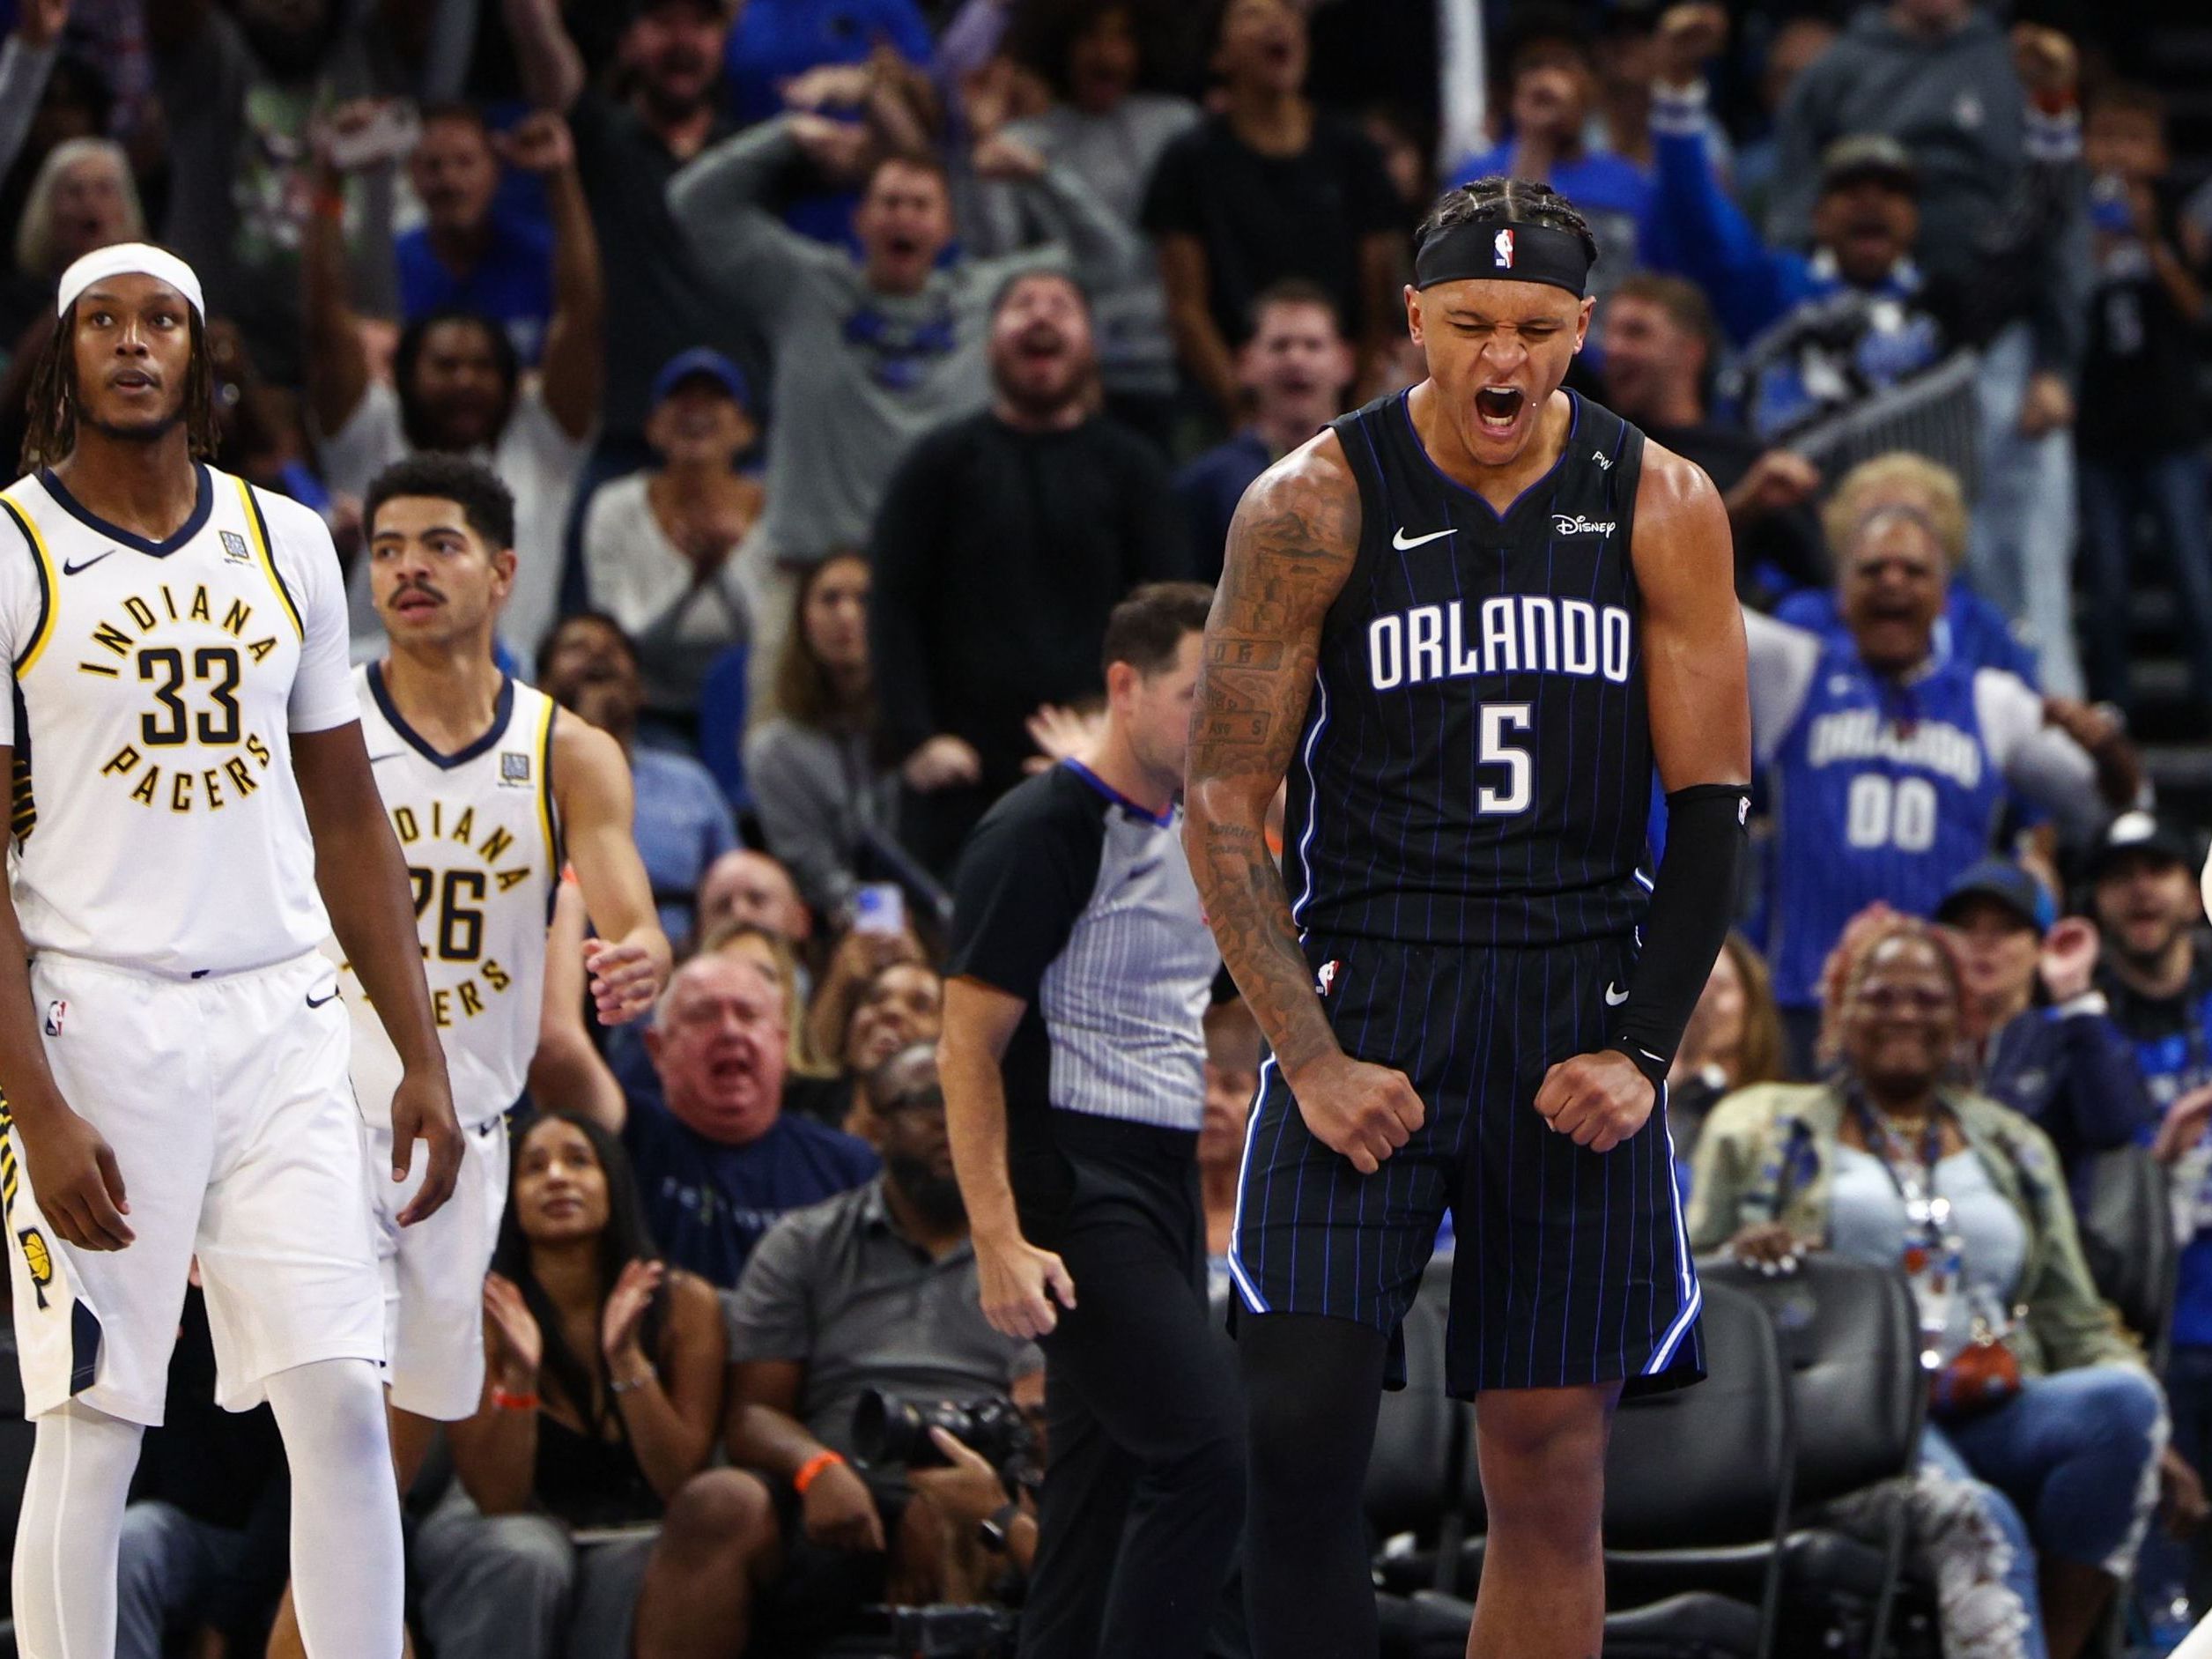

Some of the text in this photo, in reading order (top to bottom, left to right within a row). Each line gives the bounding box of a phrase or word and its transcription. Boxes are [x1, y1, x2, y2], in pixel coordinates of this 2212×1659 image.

[1591, 450, 1614, 470] PW
[78, 583, 278, 678] INDIANA
[1368, 594, 1631, 692] ORLANDO
[137, 647, 241, 746] 33
[99, 732, 271, 812] PACERS
[1476, 701, 1533, 816] 5
[393, 800, 532, 893] DIANA
[1847, 772, 1936, 853] 00
